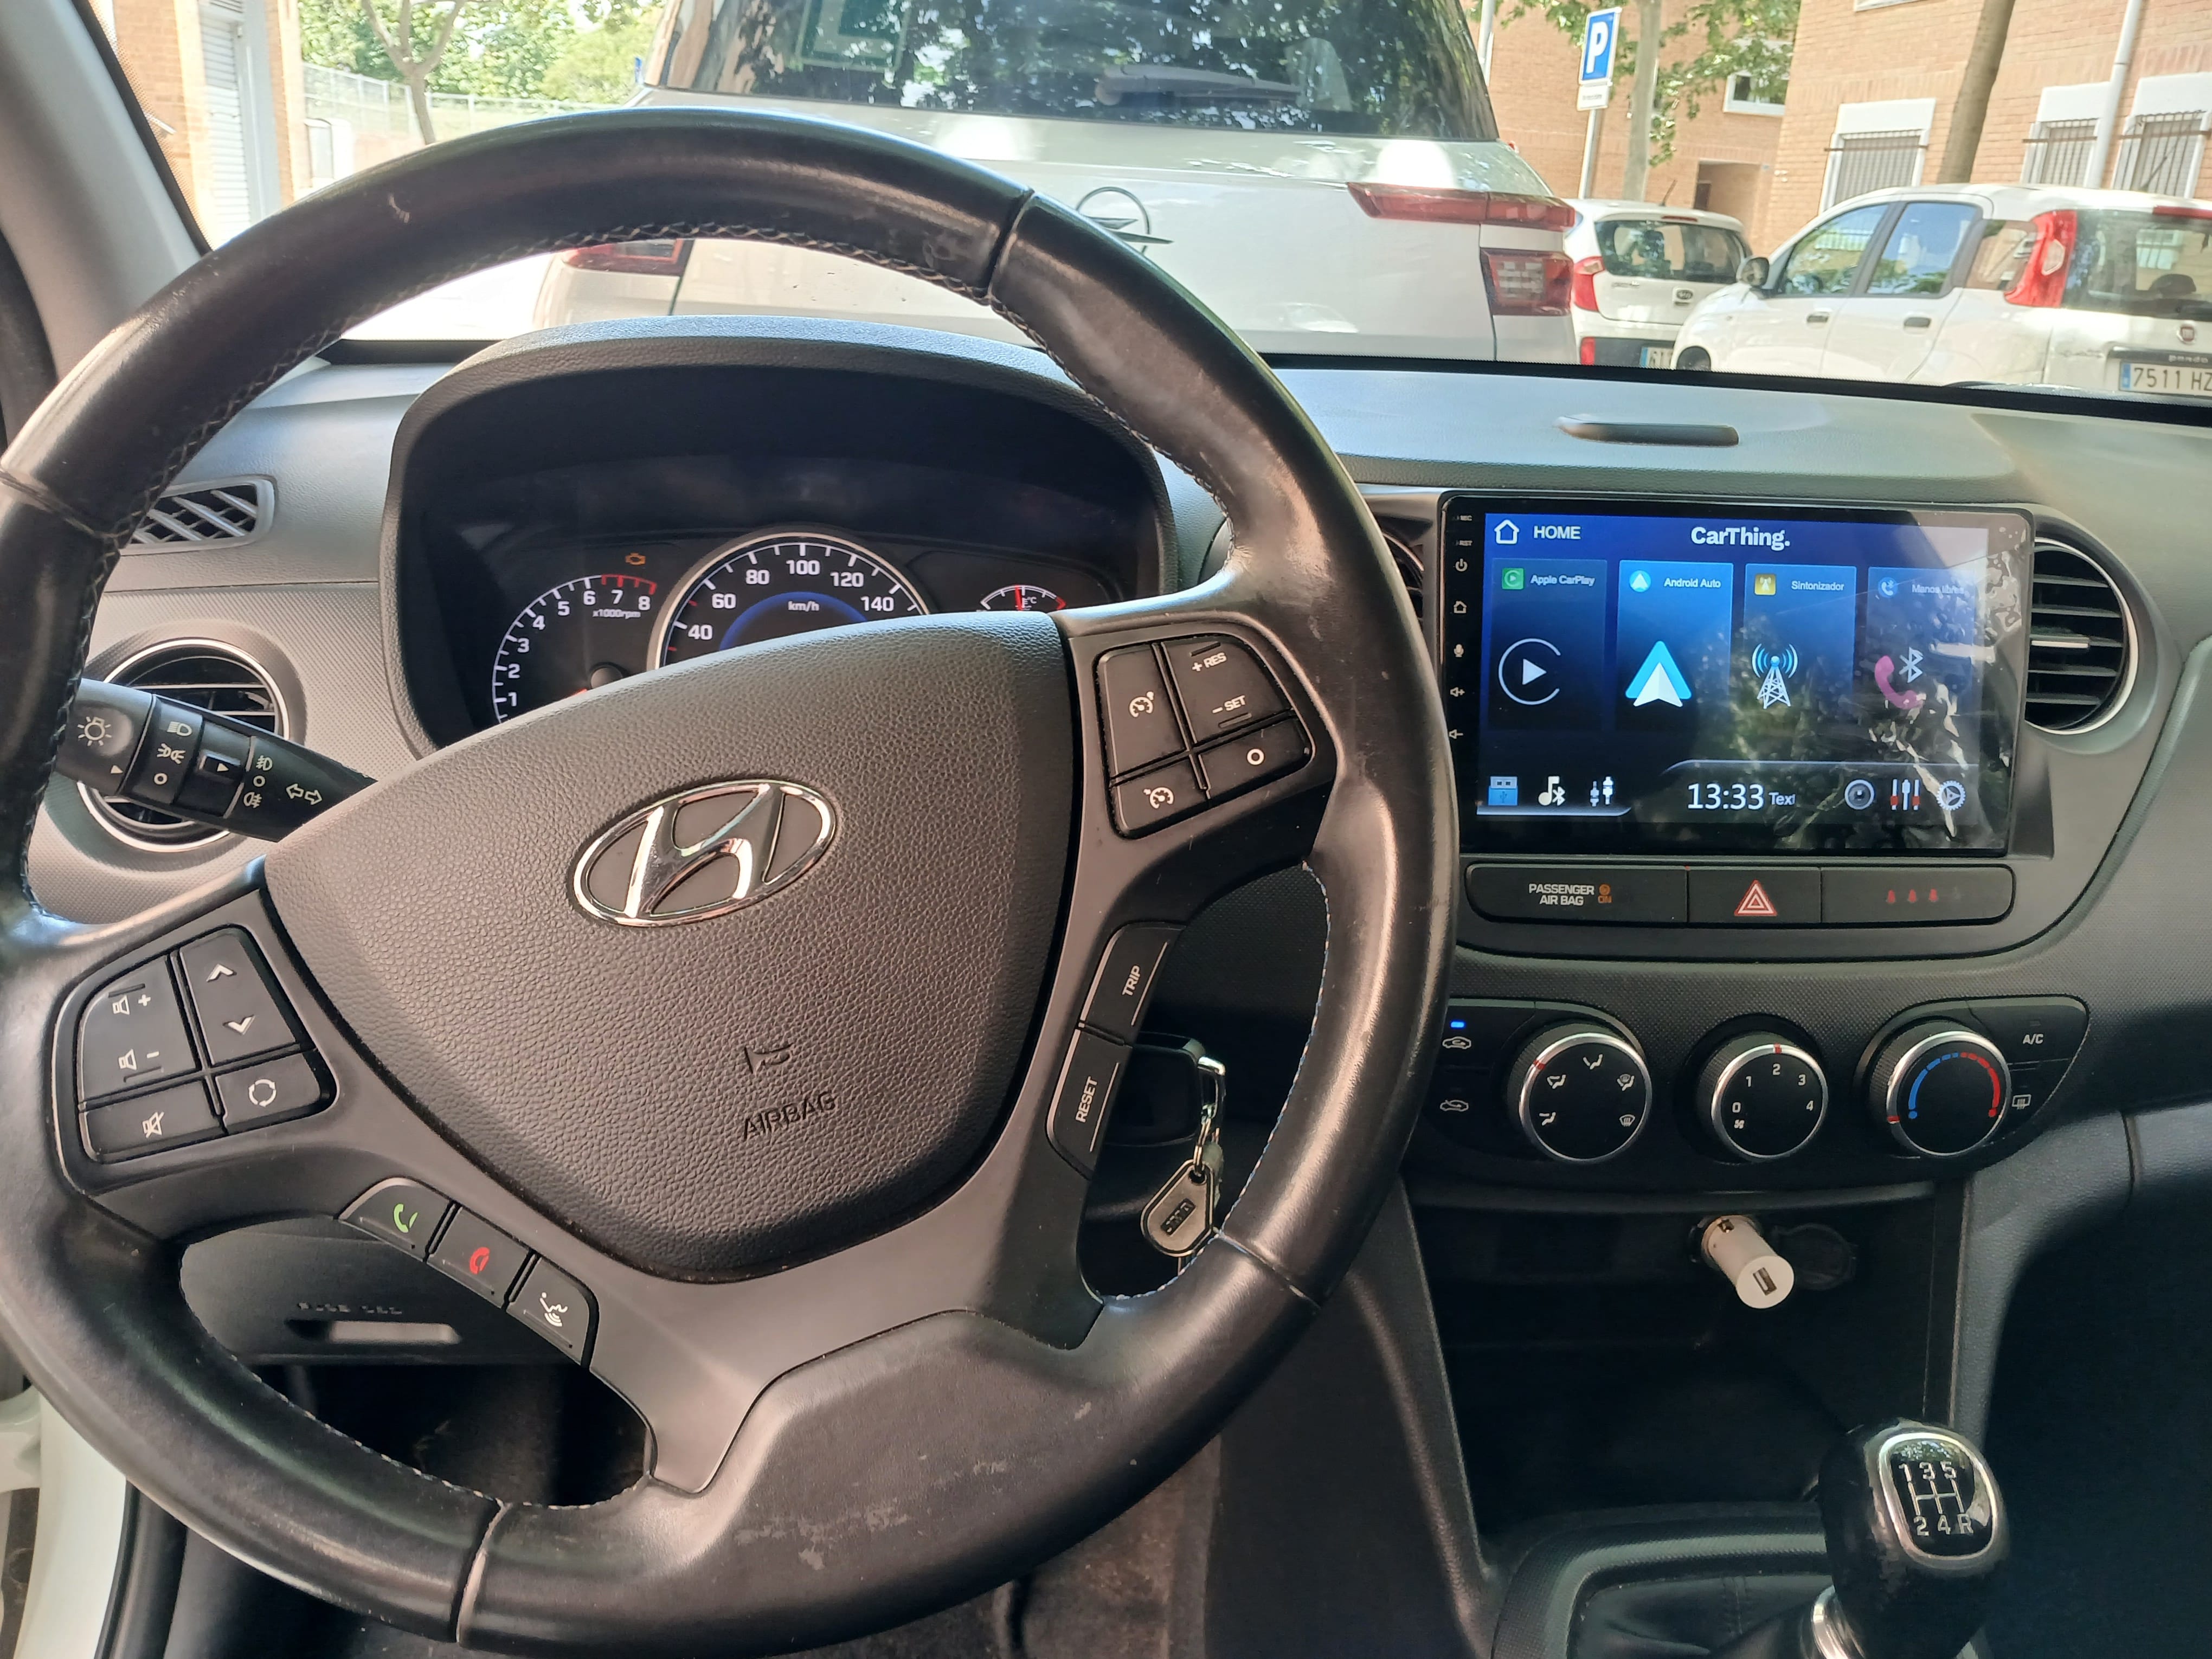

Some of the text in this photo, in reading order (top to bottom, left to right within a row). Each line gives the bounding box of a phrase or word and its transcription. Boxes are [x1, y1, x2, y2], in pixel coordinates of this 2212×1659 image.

[1586, 21, 1608, 74] P
[2133, 367, 2180, 389] 7511
[1533, 525, 1581, 540] HOME
[1690, 526, 1790, 551] CarThing.
[786, 560, 820, 576] 100
[745, 569, 770, 586] 80
[831, 571, 864, 588] 120
[1530, 574, 1596, 587] Apple CarPlay
[1663, 577, 1721, 588] Android Auto
[1791, 580, 1844, 591] Sintonizador
[1911, 584, 1940, 593] Manos
[583, 590, 596, 605] 6
[612, 589, 623, 605] 7
[638, 595, 651, 611] 8
[712, 594, 736, 609] 60
[861, 596, 894, 612] 140
[557, 601, 570, 617] 5
[593, 609, 641, 619] x1000rpm
[788, 600, 820, 613] km/h
[532, 615, 545, 631] 4
[688, 625, 713, 640] 40
[517, 638, 530, 653] 3
[1204, 652, 1227, 667] RES
[508, 663, 520, 679] 2
[508, 692, 517, 707] 1
[1224, 696, 1245, 711] SET
[1687, 783, 1765, 810] 13:33
[1528, 883, 1595, 895] PASSENGER
[1539, 895, 1584, 906] AIR BAG
[1122, 965, 1142, 996] TRIP
[2022, 1033, 2044, 1045] A/C
[1772, 1063, 1781, 1075] 2
[1745, 1076, 1752, 1087] 1
[1798, 1074, 1806, 1086] 3
[1075, 1076, 1098, 1123] RESET
[1806, 1100, 1814, 1111] 4
[744, 1091, 837, 1139] AIRBAG
[1732, 1102, 1741, 1113] 0
[1898, 1461, 1957, 1482] 1 3 5
[1913, 1513, 1975, 1536] 2 4 R
